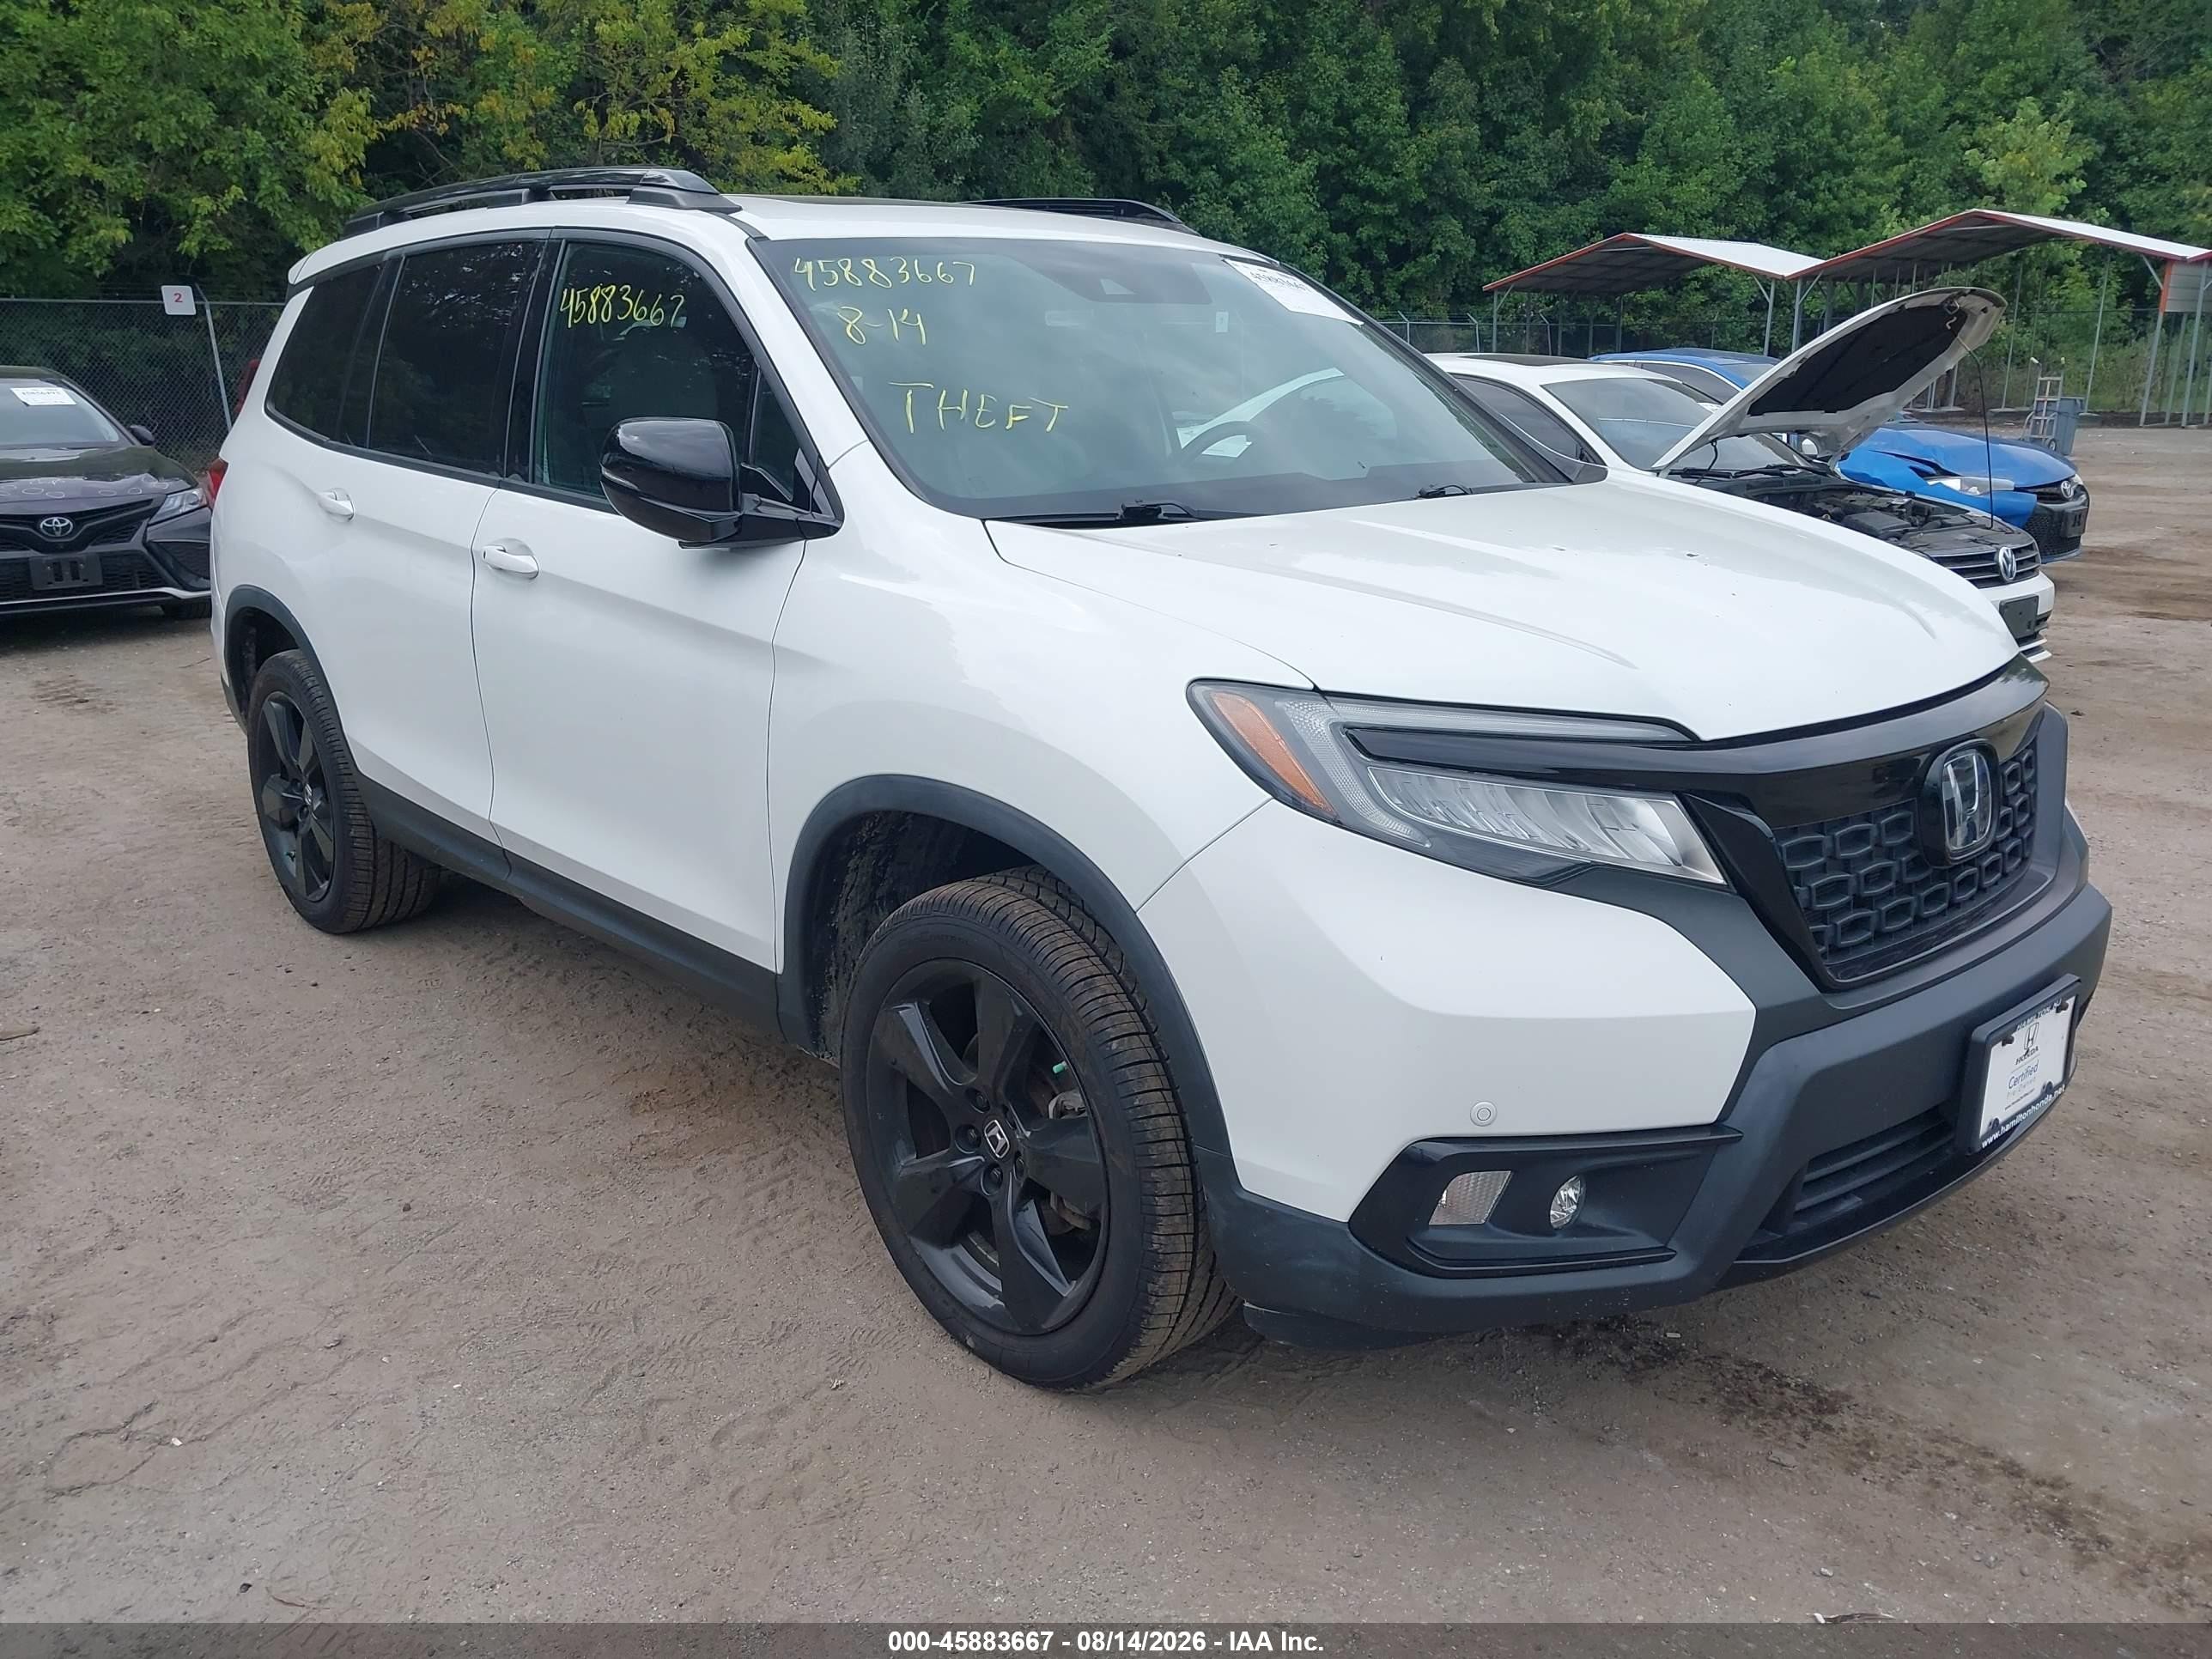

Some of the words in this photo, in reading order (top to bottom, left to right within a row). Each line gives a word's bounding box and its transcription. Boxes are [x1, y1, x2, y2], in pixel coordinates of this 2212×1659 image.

[793, 257, 975, 291] 45883667
[173, 293, 183, 303] 2
[559, 284, 685, 329] 45883667
[837, 306, 927, 345] 8-14
[888, 382, 1069, 434] THEFT
[2008, 1058, 2039, 1089] Certified
[1981, 1084, 2065, 1149] www.hamiltonhonda.net
